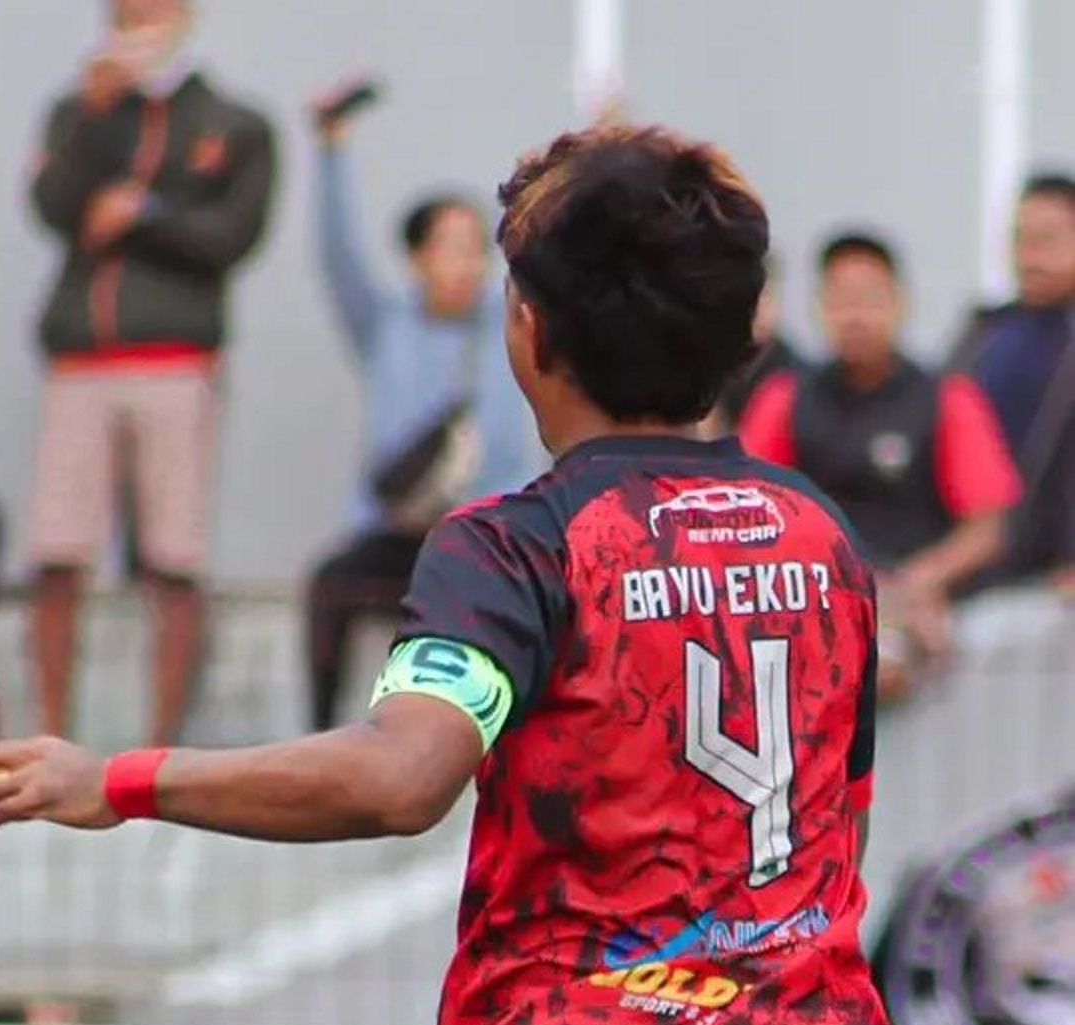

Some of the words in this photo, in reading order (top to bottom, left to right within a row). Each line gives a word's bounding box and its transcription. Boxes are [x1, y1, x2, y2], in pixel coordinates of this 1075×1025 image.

[737, 525, 777, 542] CAR
[623, 567, 716, 621] BAYU
[727, 561, 806, 615] EKO
[685, 638, 793, 888] 4
[619, 994, 685, 1017] SPORT
